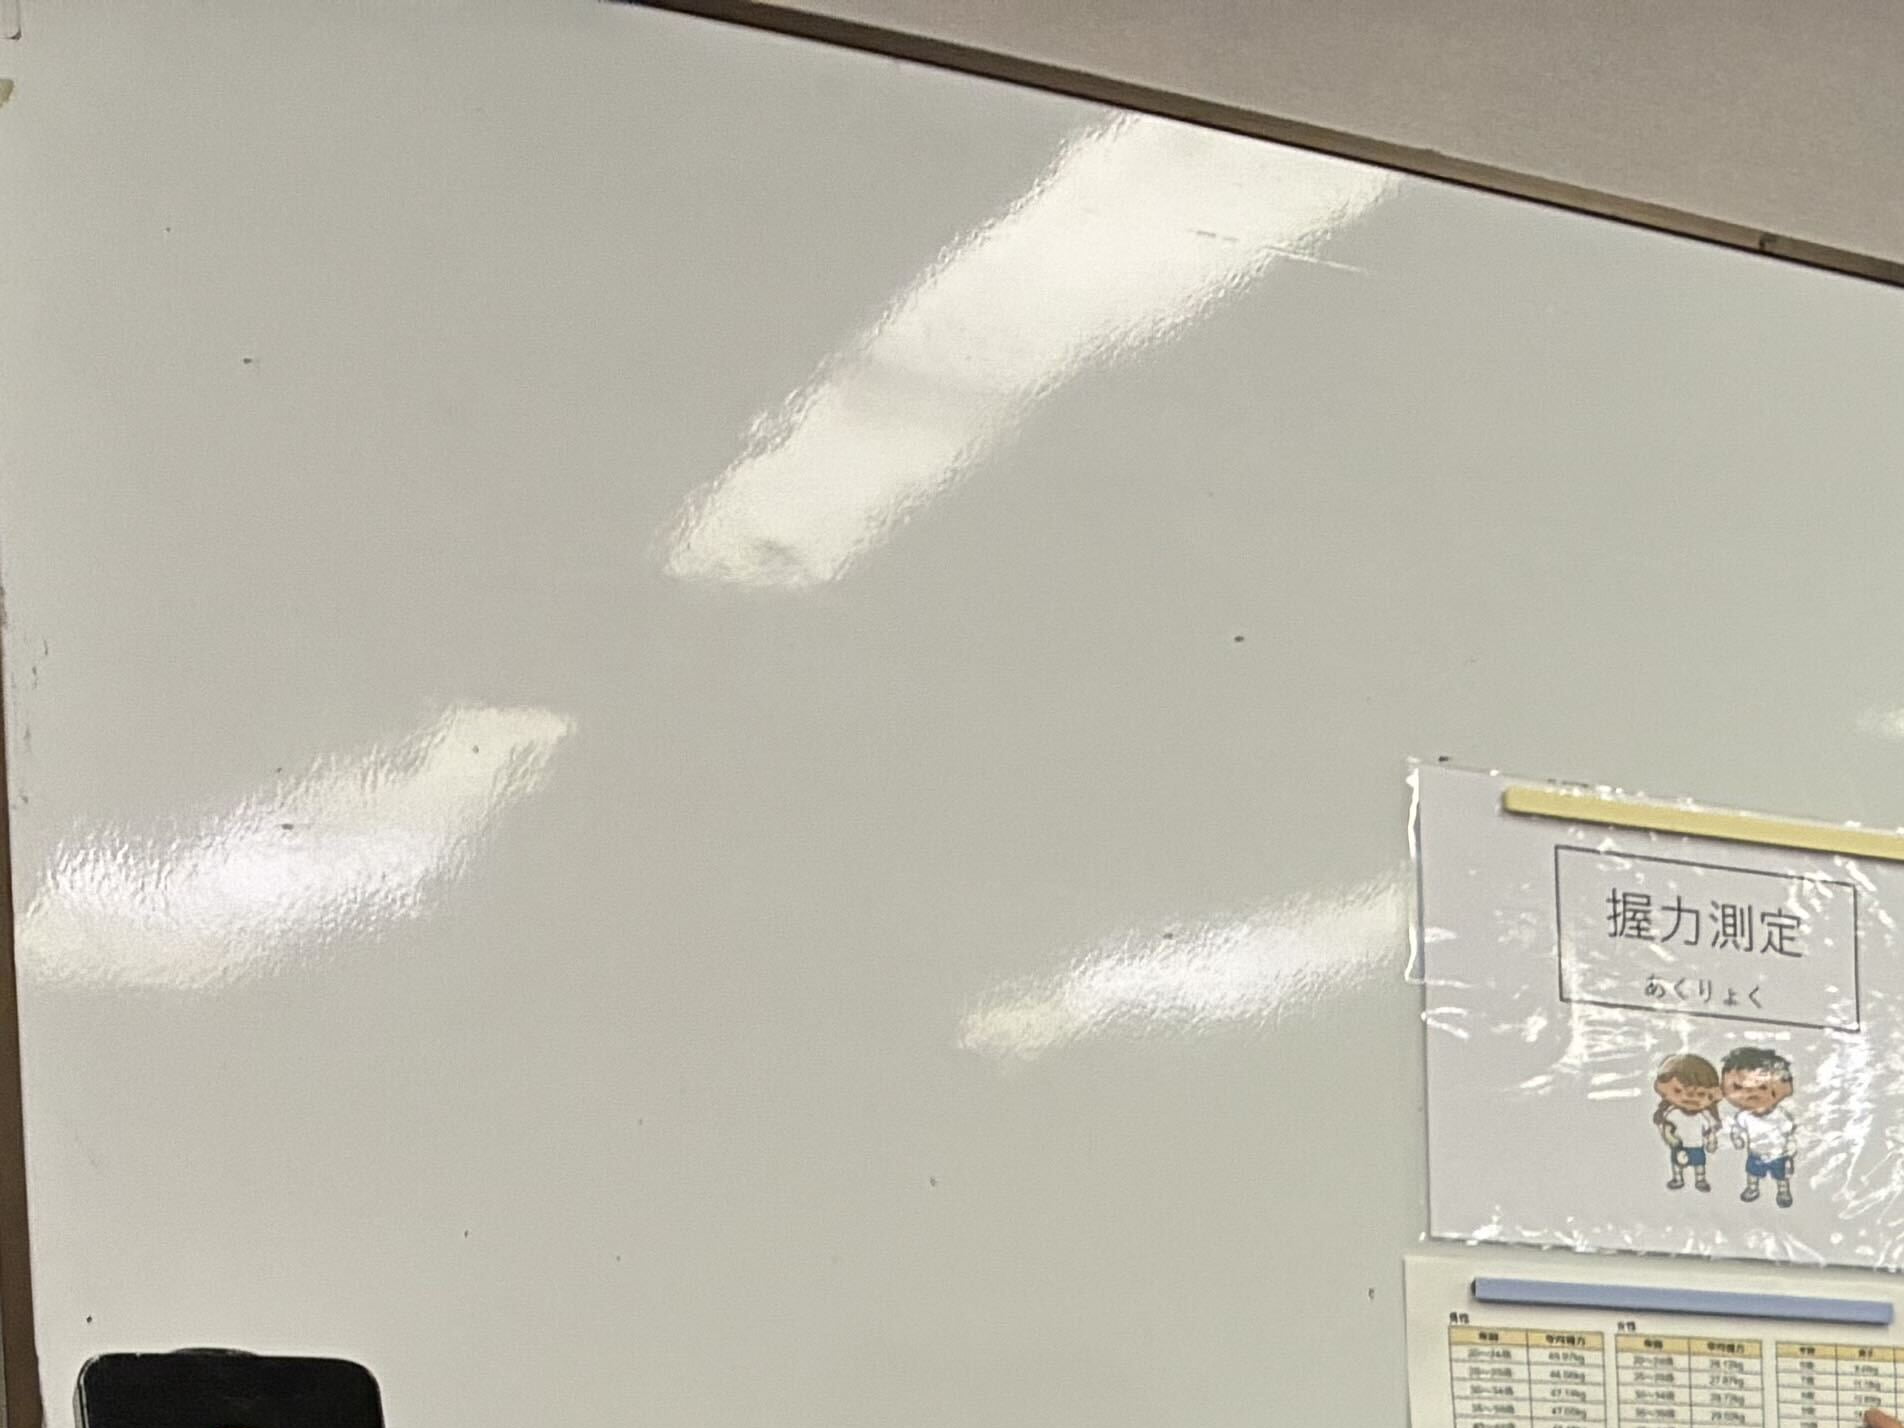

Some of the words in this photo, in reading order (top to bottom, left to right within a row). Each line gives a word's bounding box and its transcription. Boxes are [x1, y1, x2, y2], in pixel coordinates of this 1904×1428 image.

[1606, 887, 1804, 957] 握力測定
[1645, 973, 1764, 1009] あくりょく
